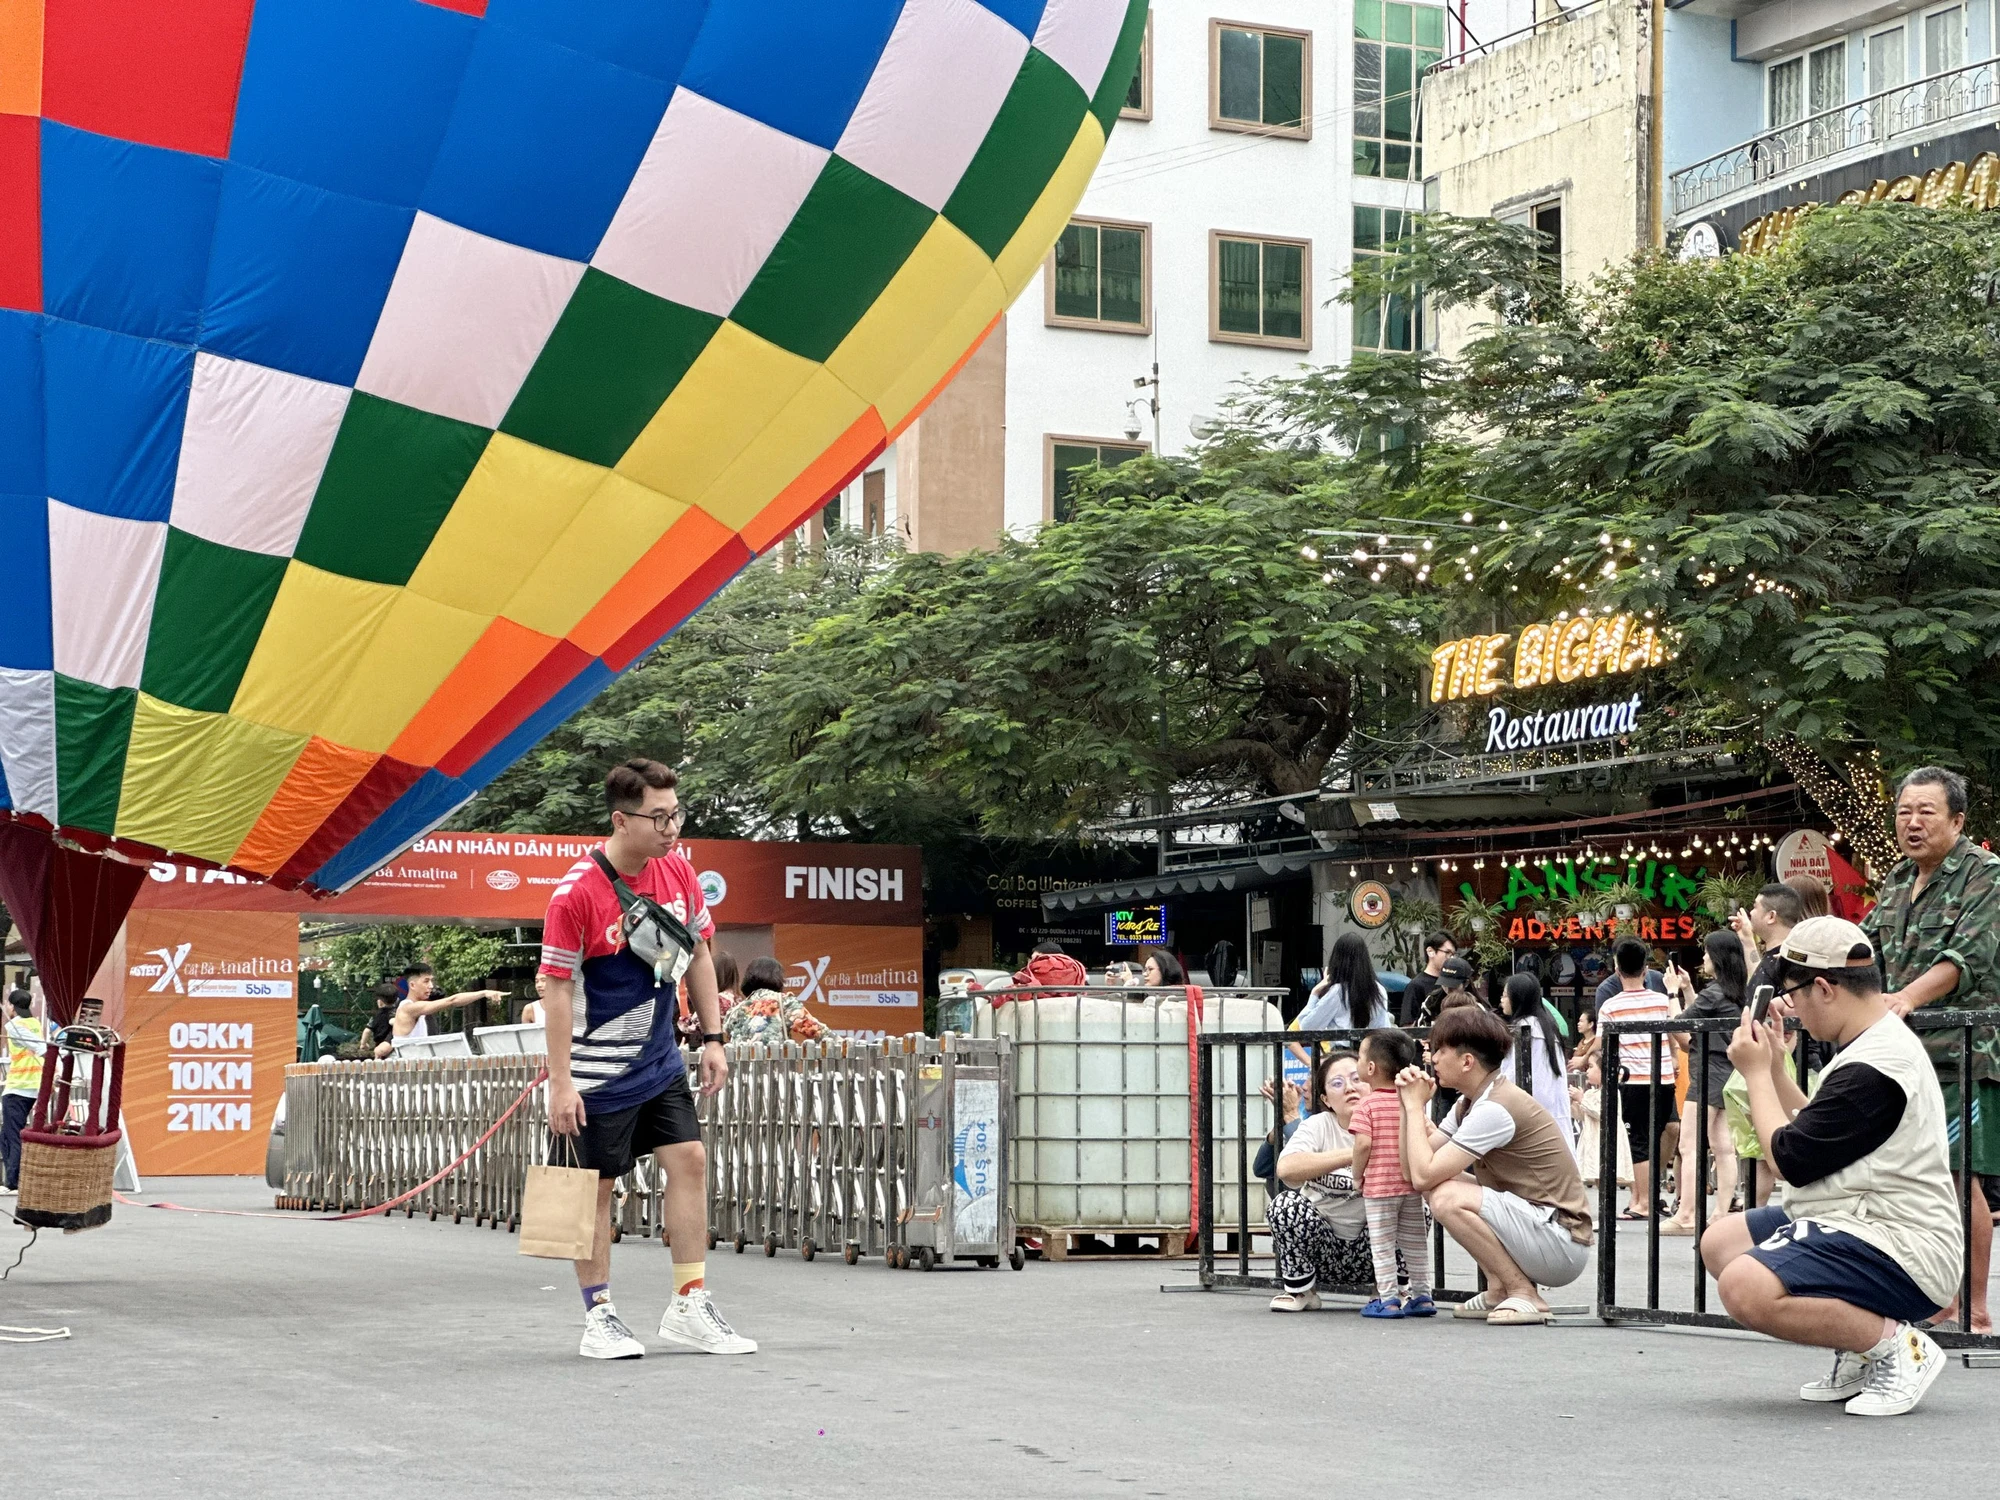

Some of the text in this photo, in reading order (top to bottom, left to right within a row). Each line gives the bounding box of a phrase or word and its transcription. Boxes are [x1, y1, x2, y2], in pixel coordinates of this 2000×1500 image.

[1431, 633, 1511, 703] THE
[1485, 692, 1641, 752] Restaurant
[412, 839, 453, 854] BAN
[457, 838, 510, 856] NHÂN
[514, 839, 552, 857] DÂN
[397, 866, 458, 881] Amatina
[785, 866, 903, 901] FINISH
[1017, 875, 1037, 891] Ba
[996, 899, 1038, 909] COFFEE
[1115, 911, 1134, 921] KTV
[1508, 916, 1695, 940] ADVENTRES
[217, 956, 294, 977] Amatina
[853, 968, 919, 988] Amatina
[169, 1022, 253, 1049] 05KM
[168, 1061, 252, 1090] 10KM
[167, 1102, 251, 1131] 21KM
[975, 1121, 987, 1197] SUS 304
